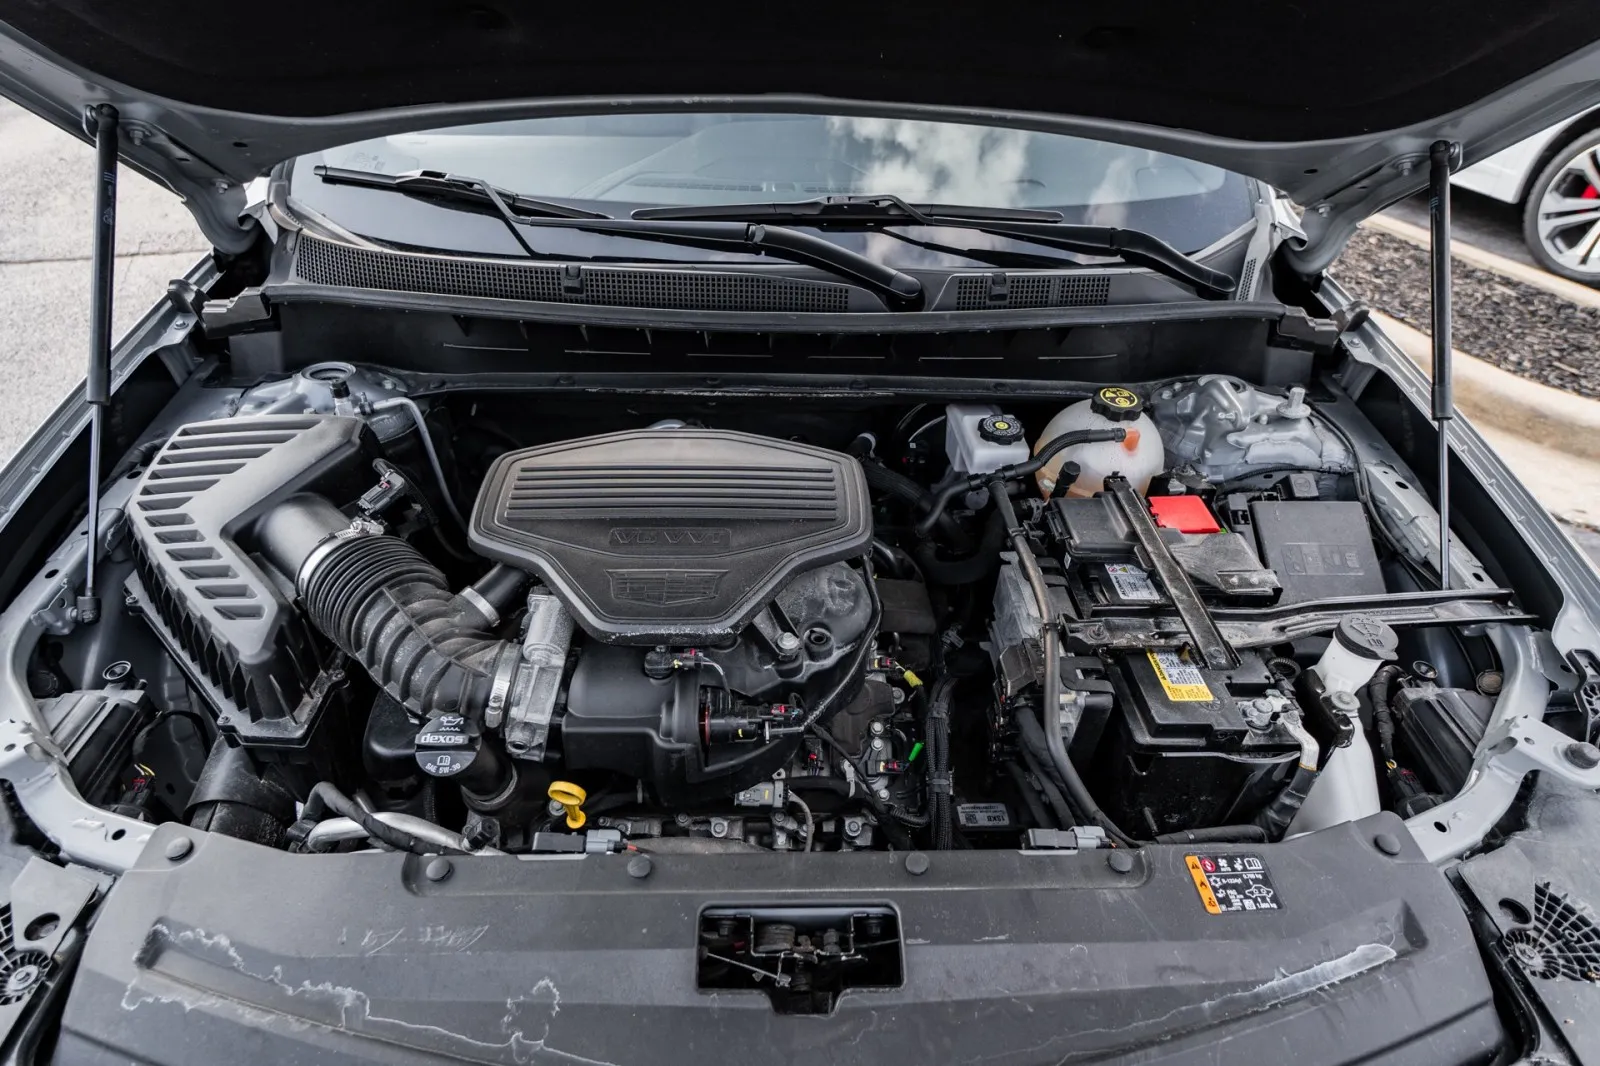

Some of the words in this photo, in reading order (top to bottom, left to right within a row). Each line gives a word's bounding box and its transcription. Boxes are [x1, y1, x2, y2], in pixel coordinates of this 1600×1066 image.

[420, 733, 466, 744] dexos
[425, 762, 438, 773] SAE
[438, 762, 461, 774] 5W-30
